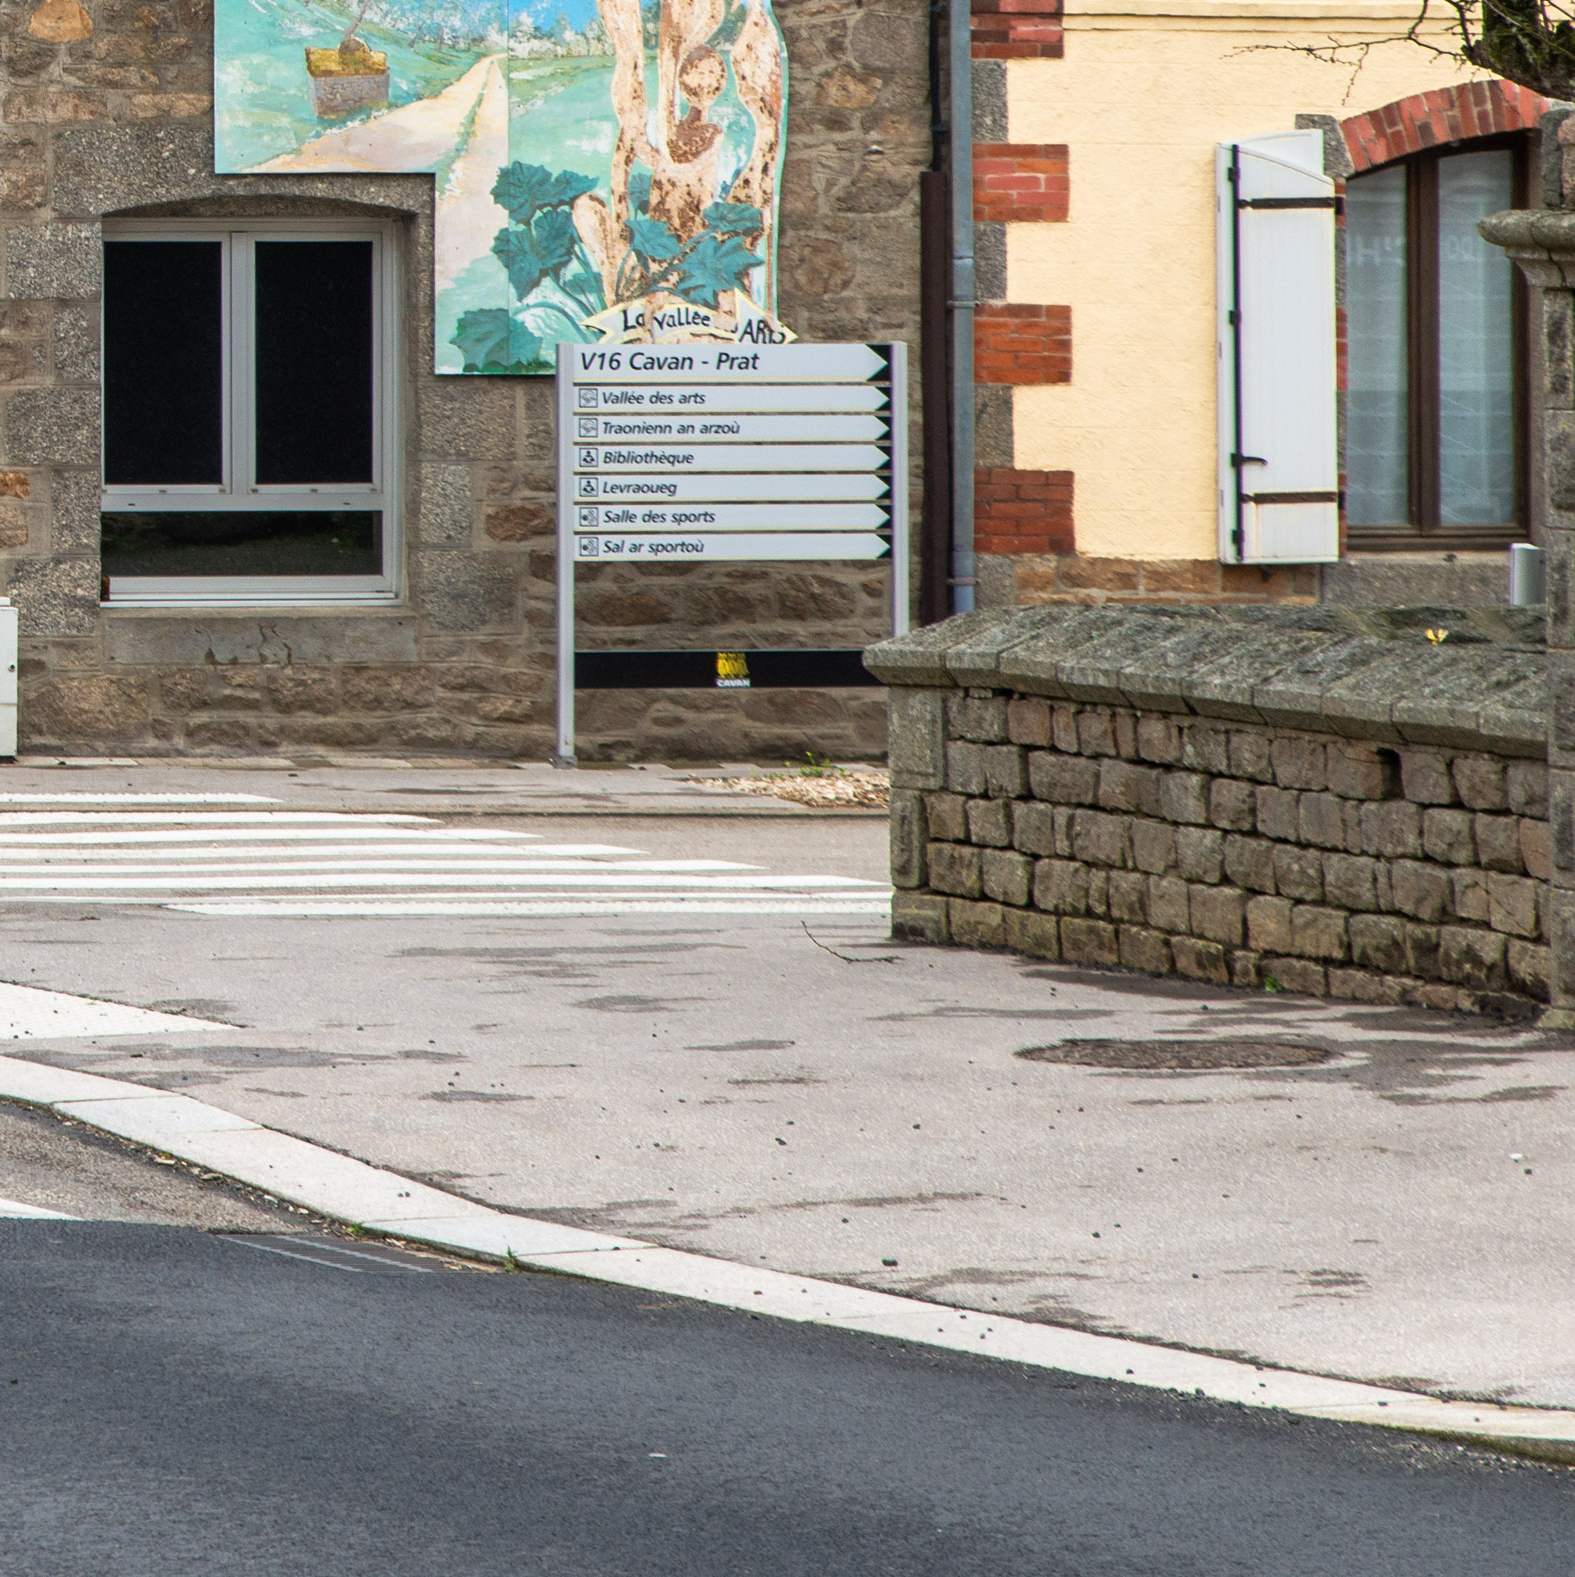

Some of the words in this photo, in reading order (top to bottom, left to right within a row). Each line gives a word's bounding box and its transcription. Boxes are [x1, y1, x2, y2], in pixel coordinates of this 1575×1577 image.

[581, 352, 622, 370] V16
[629, 352, 694, 370] Cavan
[716, 352, 760, 370] Prat
[602, 391, 644, 404] Vallée
[649, 391, 674, 404] des
[678, 392, 706, 404] arts
[603, 421, 672, 434] Traonienn
[677, 424, 695, 434] an
[699, 421, 740, 434] arzoù
[603, 450, 694, 466] Bibliothèque
[603, 481, 677, 496] Levraoueg
[603, 510, 637, 523] Salle
[642, 510, 667, 523] des
[671, 511, 715, 526] sports
[603, 540, 625, 553] Sal
[629, 542, 644, 553] ar
[648, 539, 704, 556] sportoù
[716, 679, 750, 687] CAVAN
